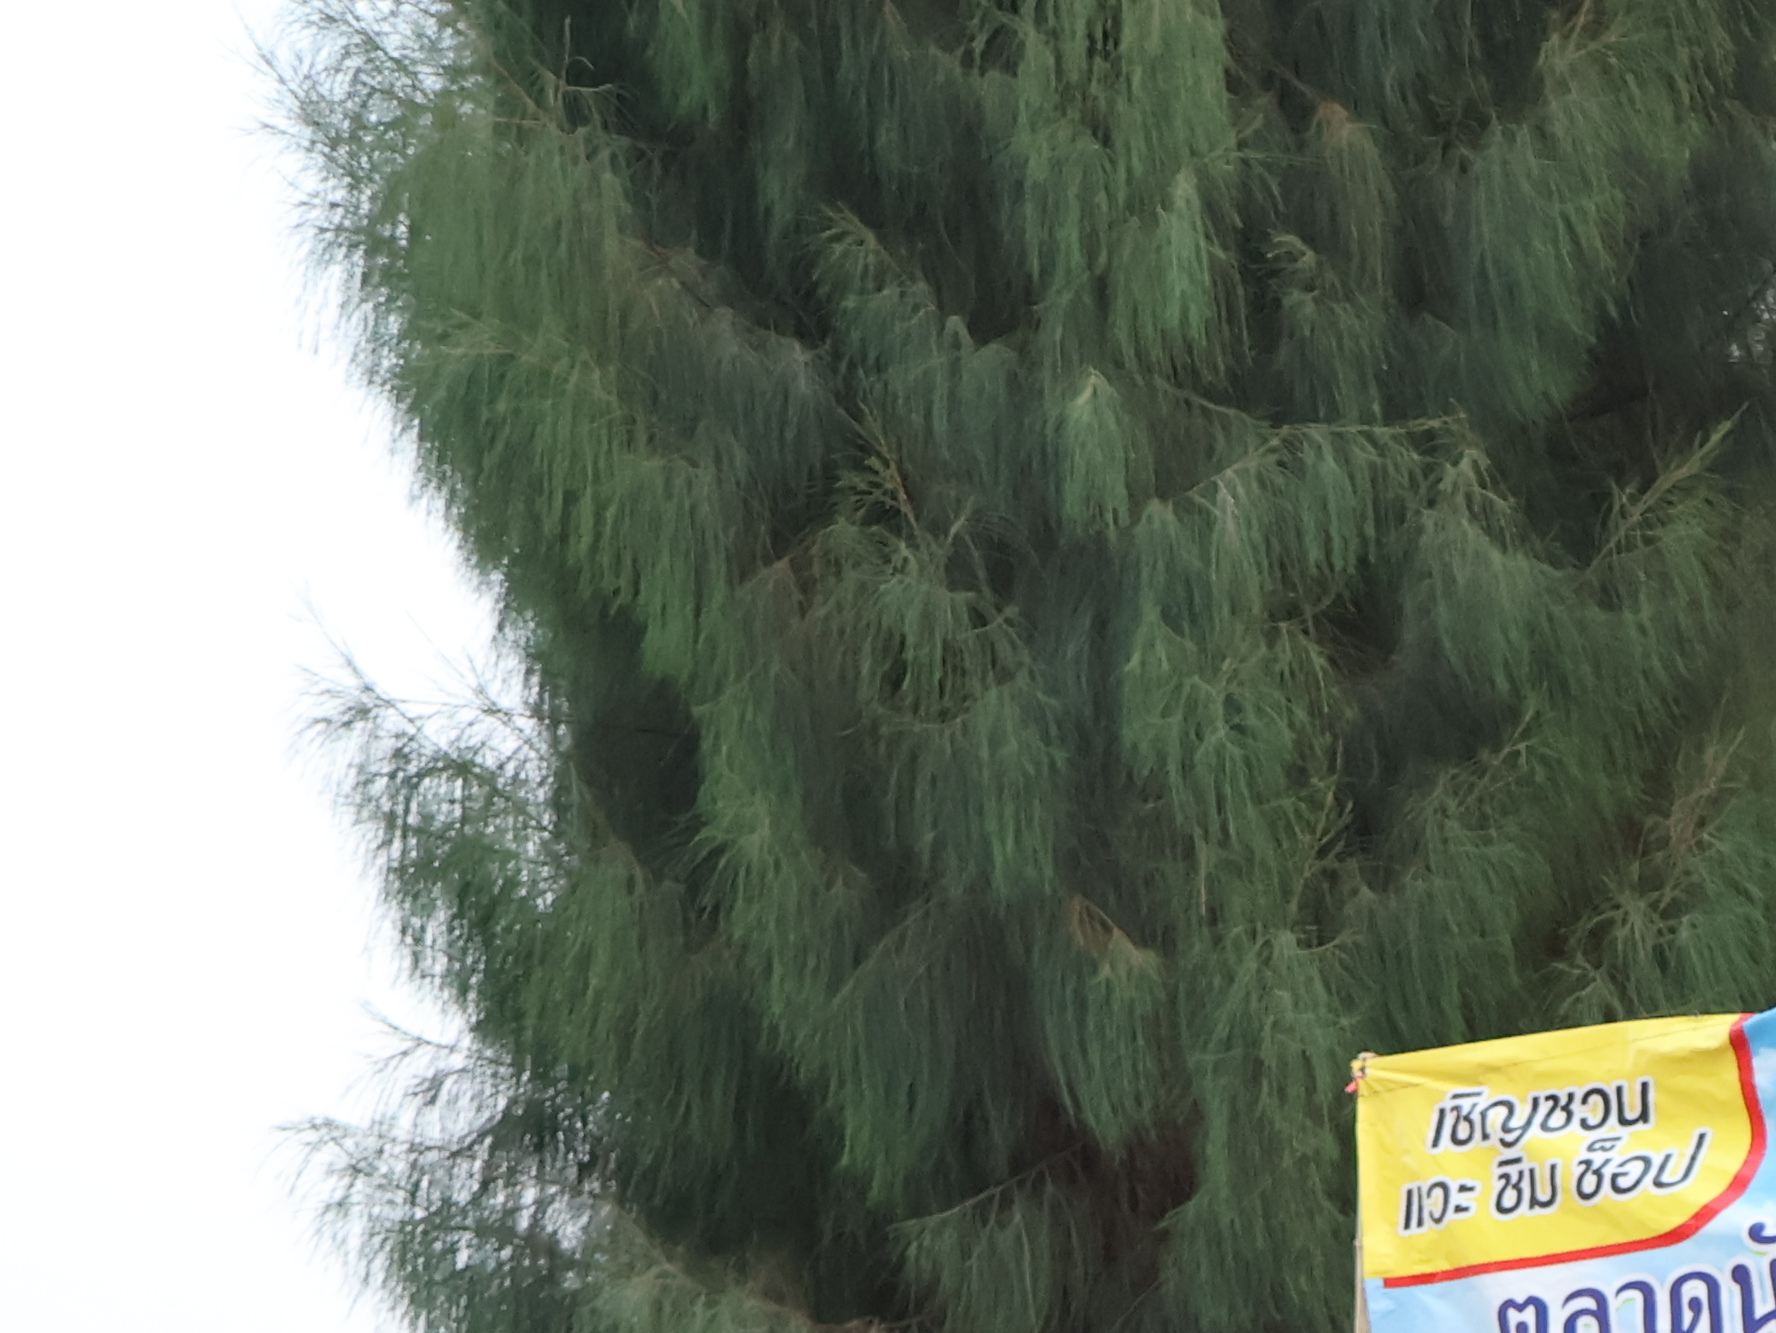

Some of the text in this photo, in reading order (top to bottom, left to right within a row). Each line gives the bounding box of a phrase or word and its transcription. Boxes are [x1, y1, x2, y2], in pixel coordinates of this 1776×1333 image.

[1432, 1080, 1650, 1149] เชิญชวน
[1403, 1132, 1706, 1230] แวะ ชิม ช็อป
